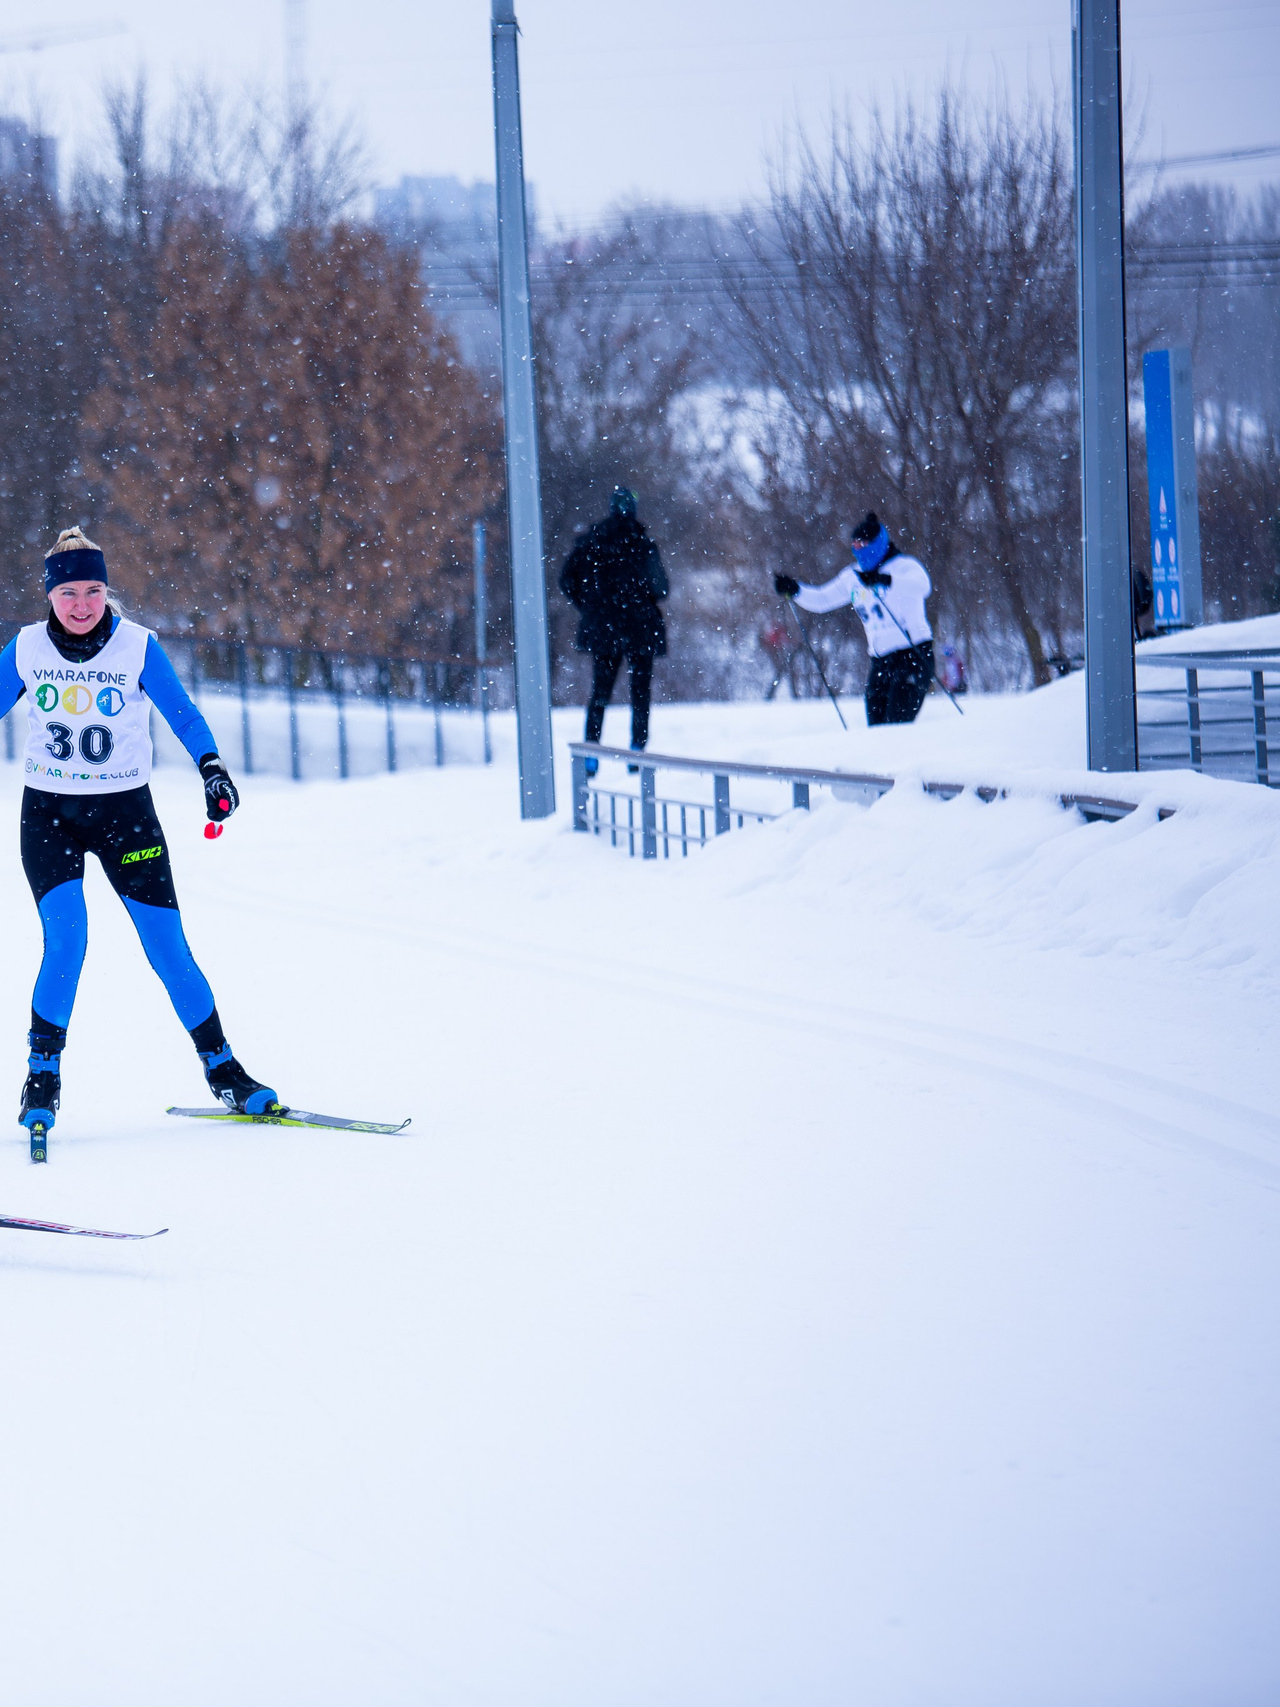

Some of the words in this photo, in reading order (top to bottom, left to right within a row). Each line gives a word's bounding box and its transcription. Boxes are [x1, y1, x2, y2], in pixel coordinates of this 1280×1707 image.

[33, 669, 127, 686] VMARAFONE
[45, 721, 114, 765] 30
[122, 846, 162, 864] KV+
